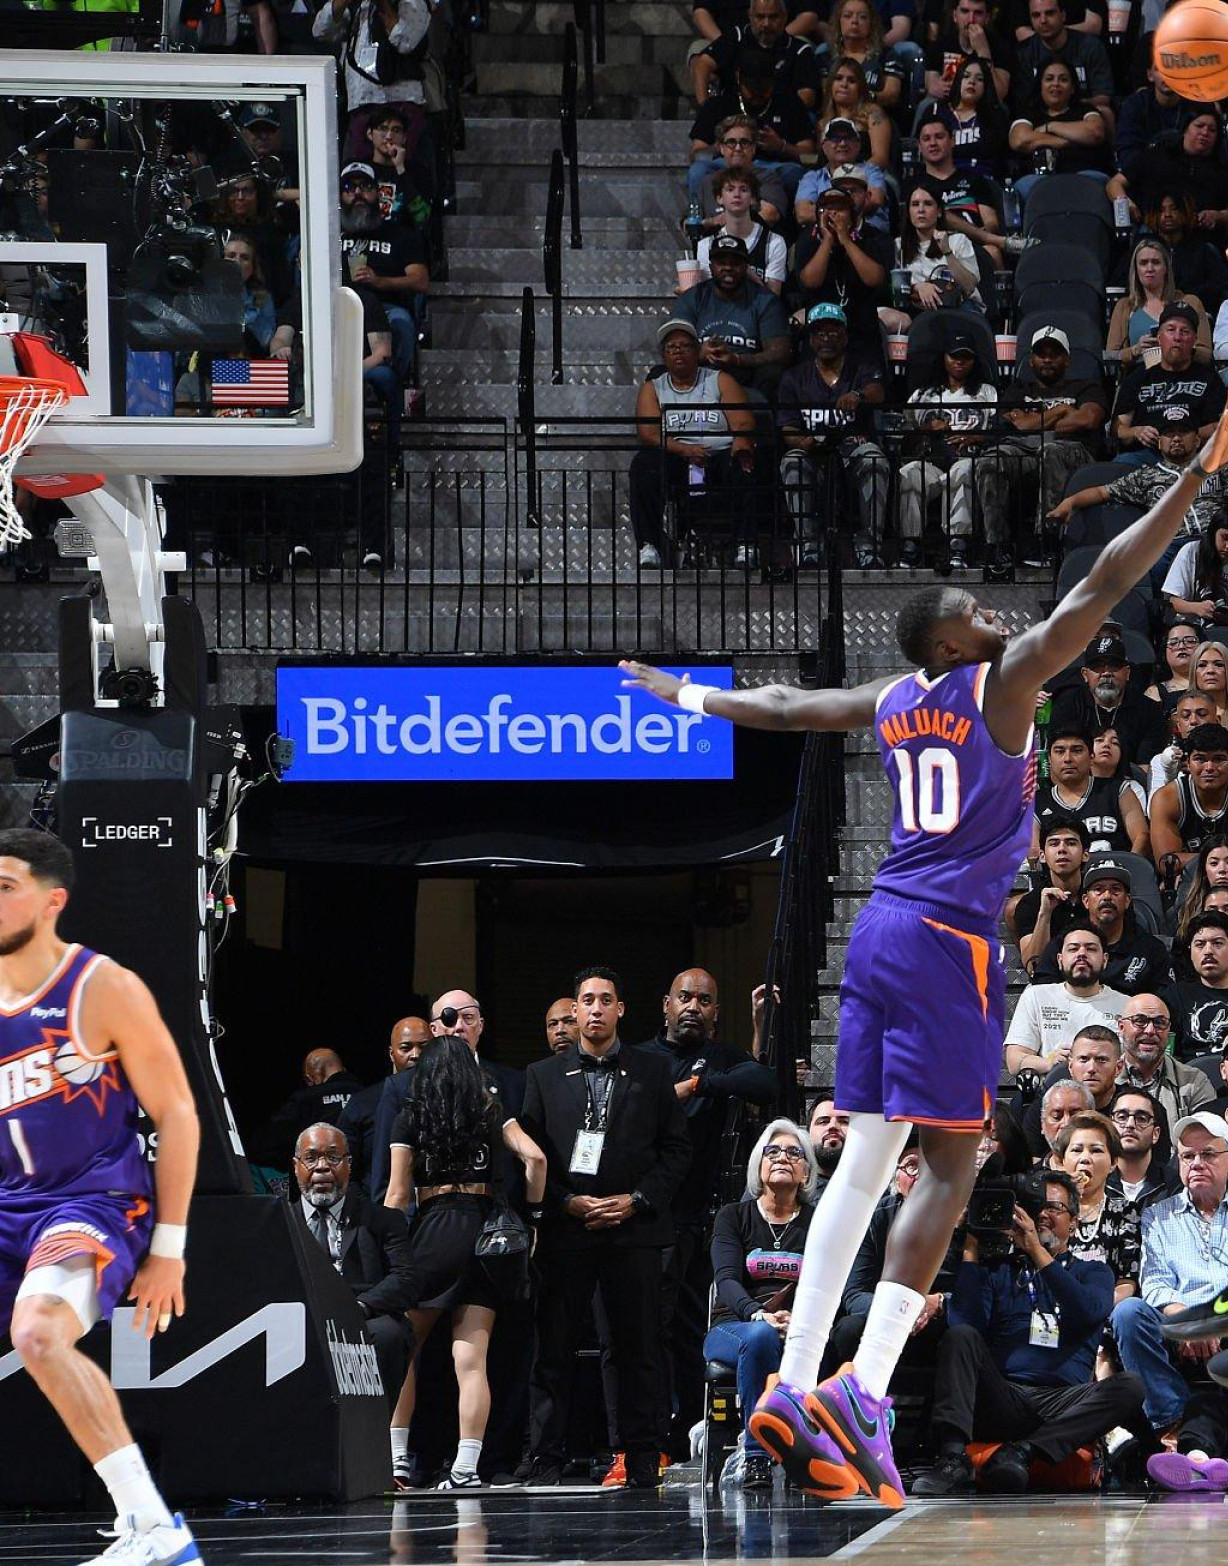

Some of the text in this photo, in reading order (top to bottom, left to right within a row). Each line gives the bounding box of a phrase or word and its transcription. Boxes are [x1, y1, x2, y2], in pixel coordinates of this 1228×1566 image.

[1159, 51, 1221, 68] Wilson
[340, 239, 391, 255] PURS
[301, 693, 703, 755] Bitdefender
[879, 708, 972, 747] MALUACH
[66, 749, 187, 774] SPALDING
[893, 747, 960, 834] 10
[94, 825, 161, 842] LEDGER
[1043, 1023, 1062, 1031] 2021
[8, 1117, 36, 1176] 1
